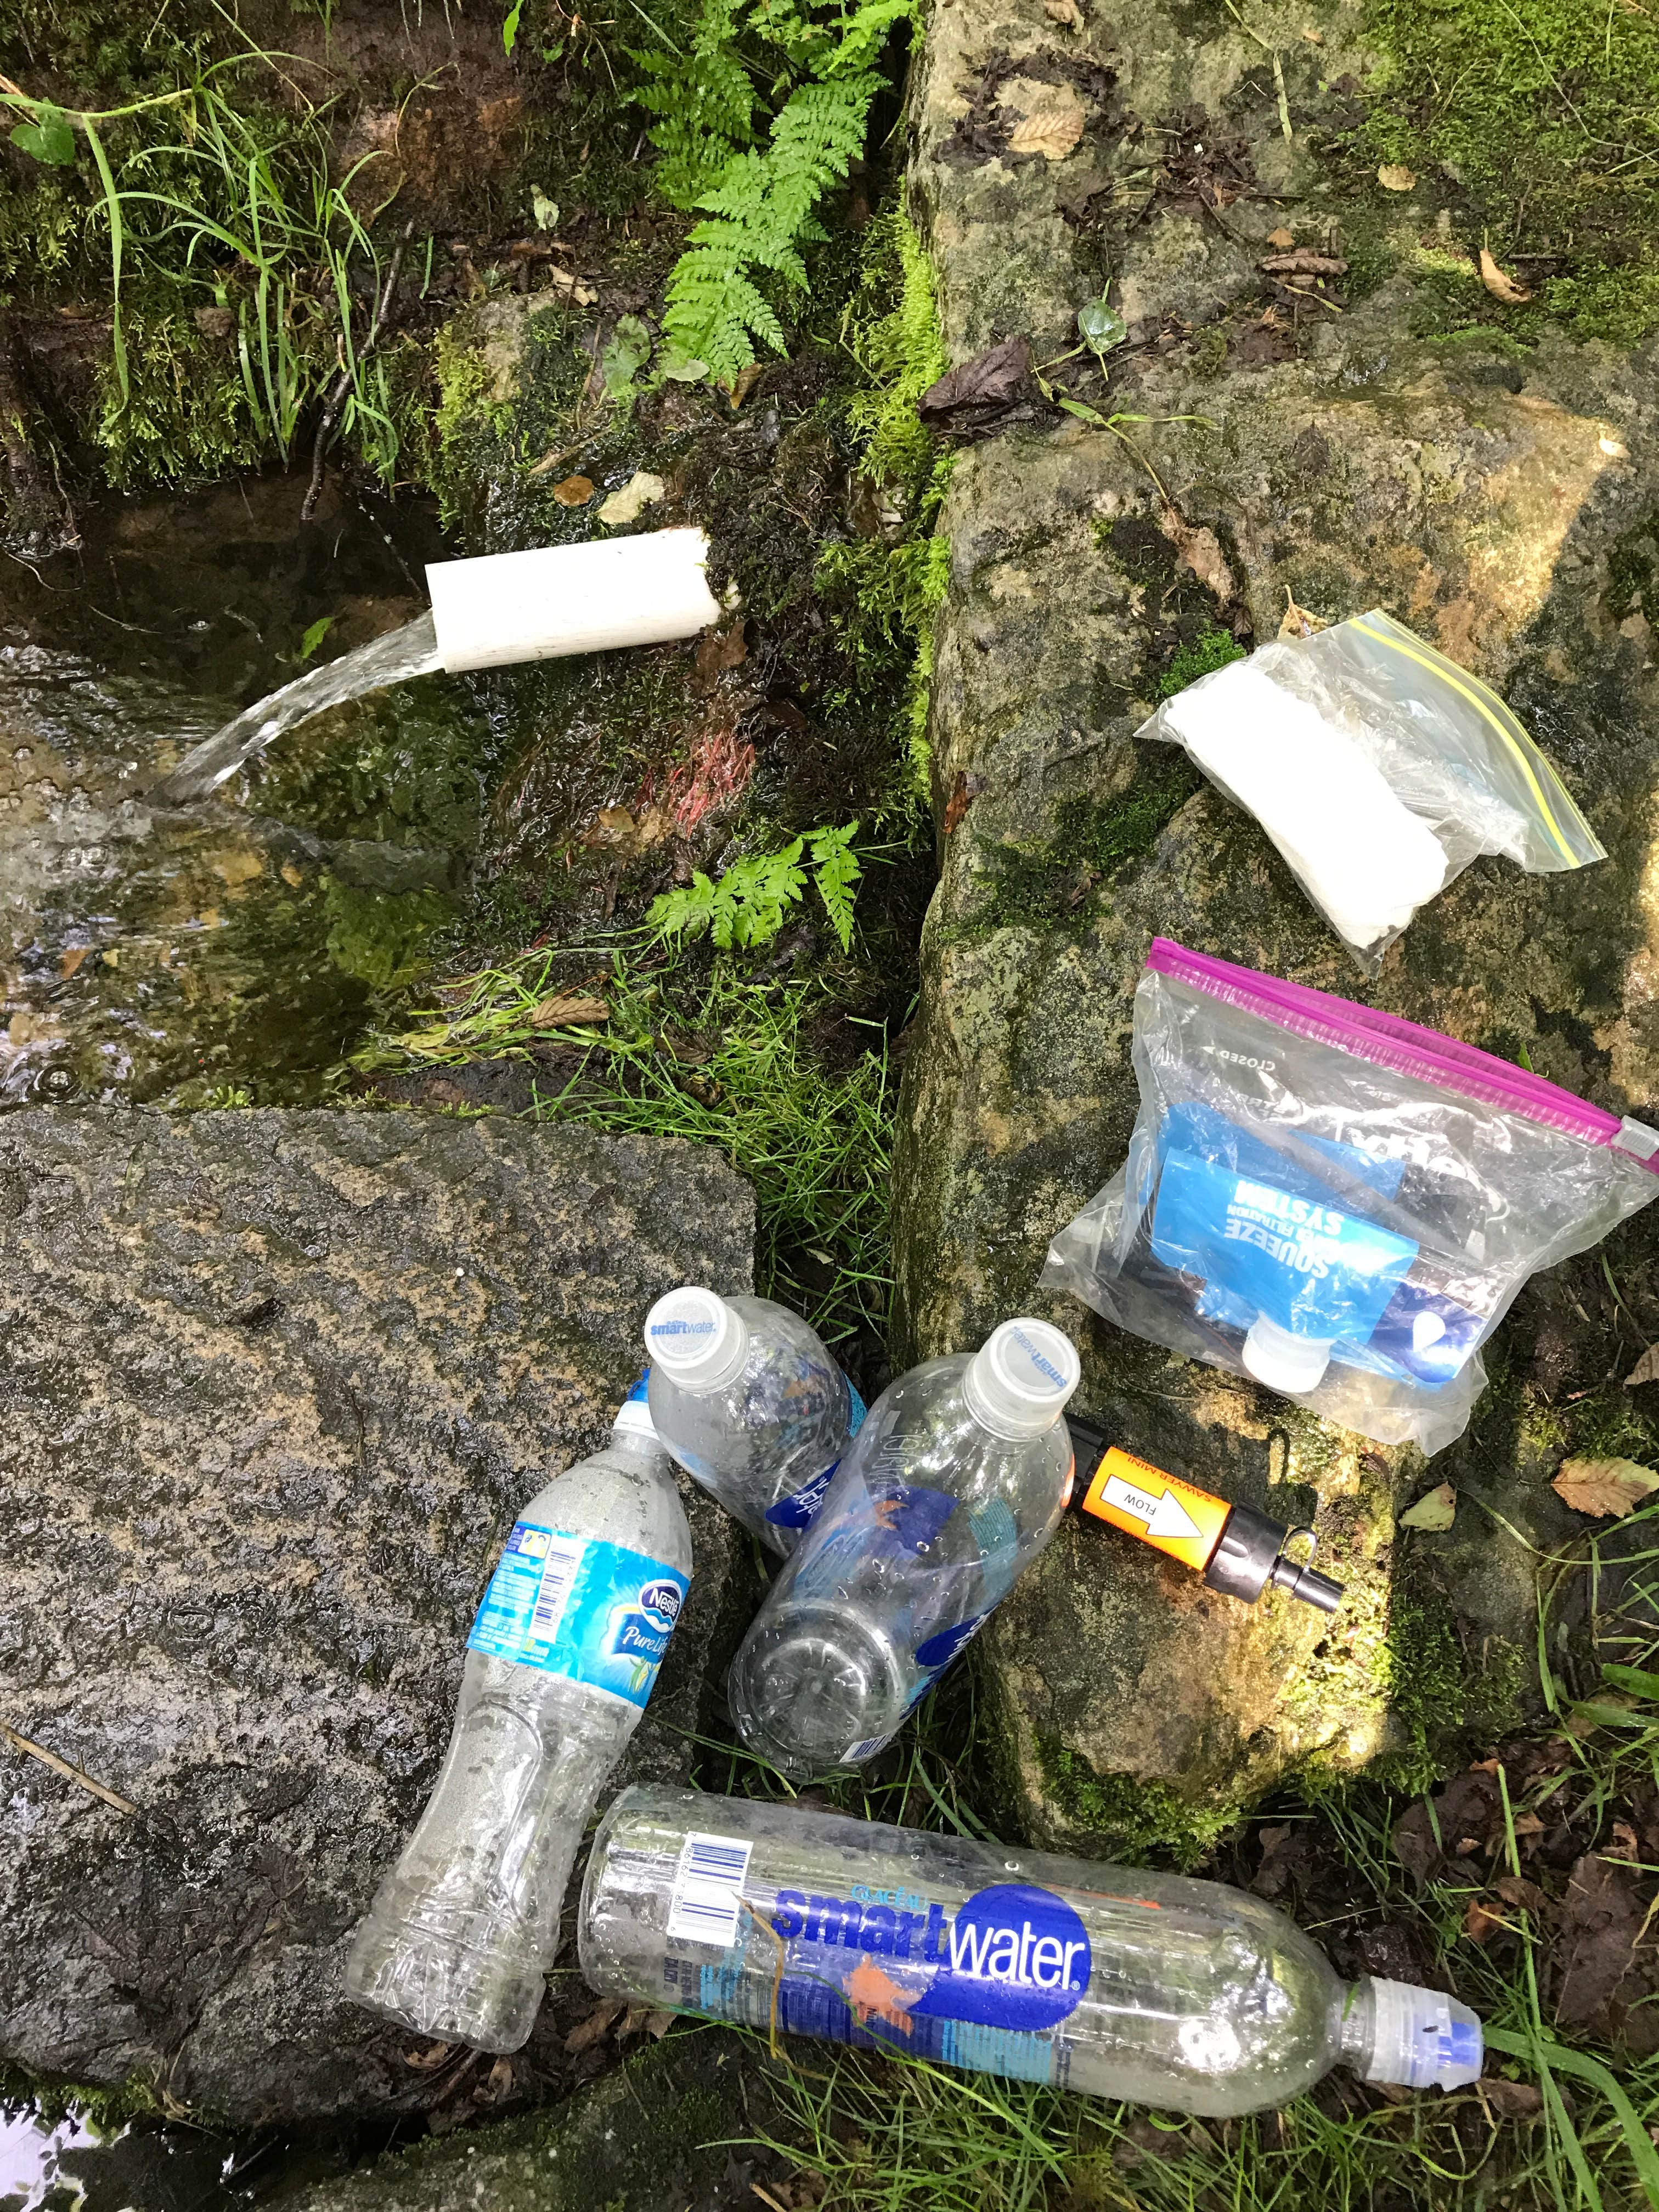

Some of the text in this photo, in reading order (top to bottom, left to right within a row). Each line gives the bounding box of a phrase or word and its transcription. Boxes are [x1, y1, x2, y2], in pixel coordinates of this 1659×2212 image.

[1227, 1204, 1295, 1237] FILTRATION
[1224, 1218, 1329, 1279] SQUEEZE
[1127, 1457, 1212, 1502] SAWYER MINI
[1124, 1494, 1156, 1515] FLOW
[649, 1588, 679, 1617] Nestlé
[623, 1626, 656, 1651] Pure
[680, 1847, 693, 1877] 86162
